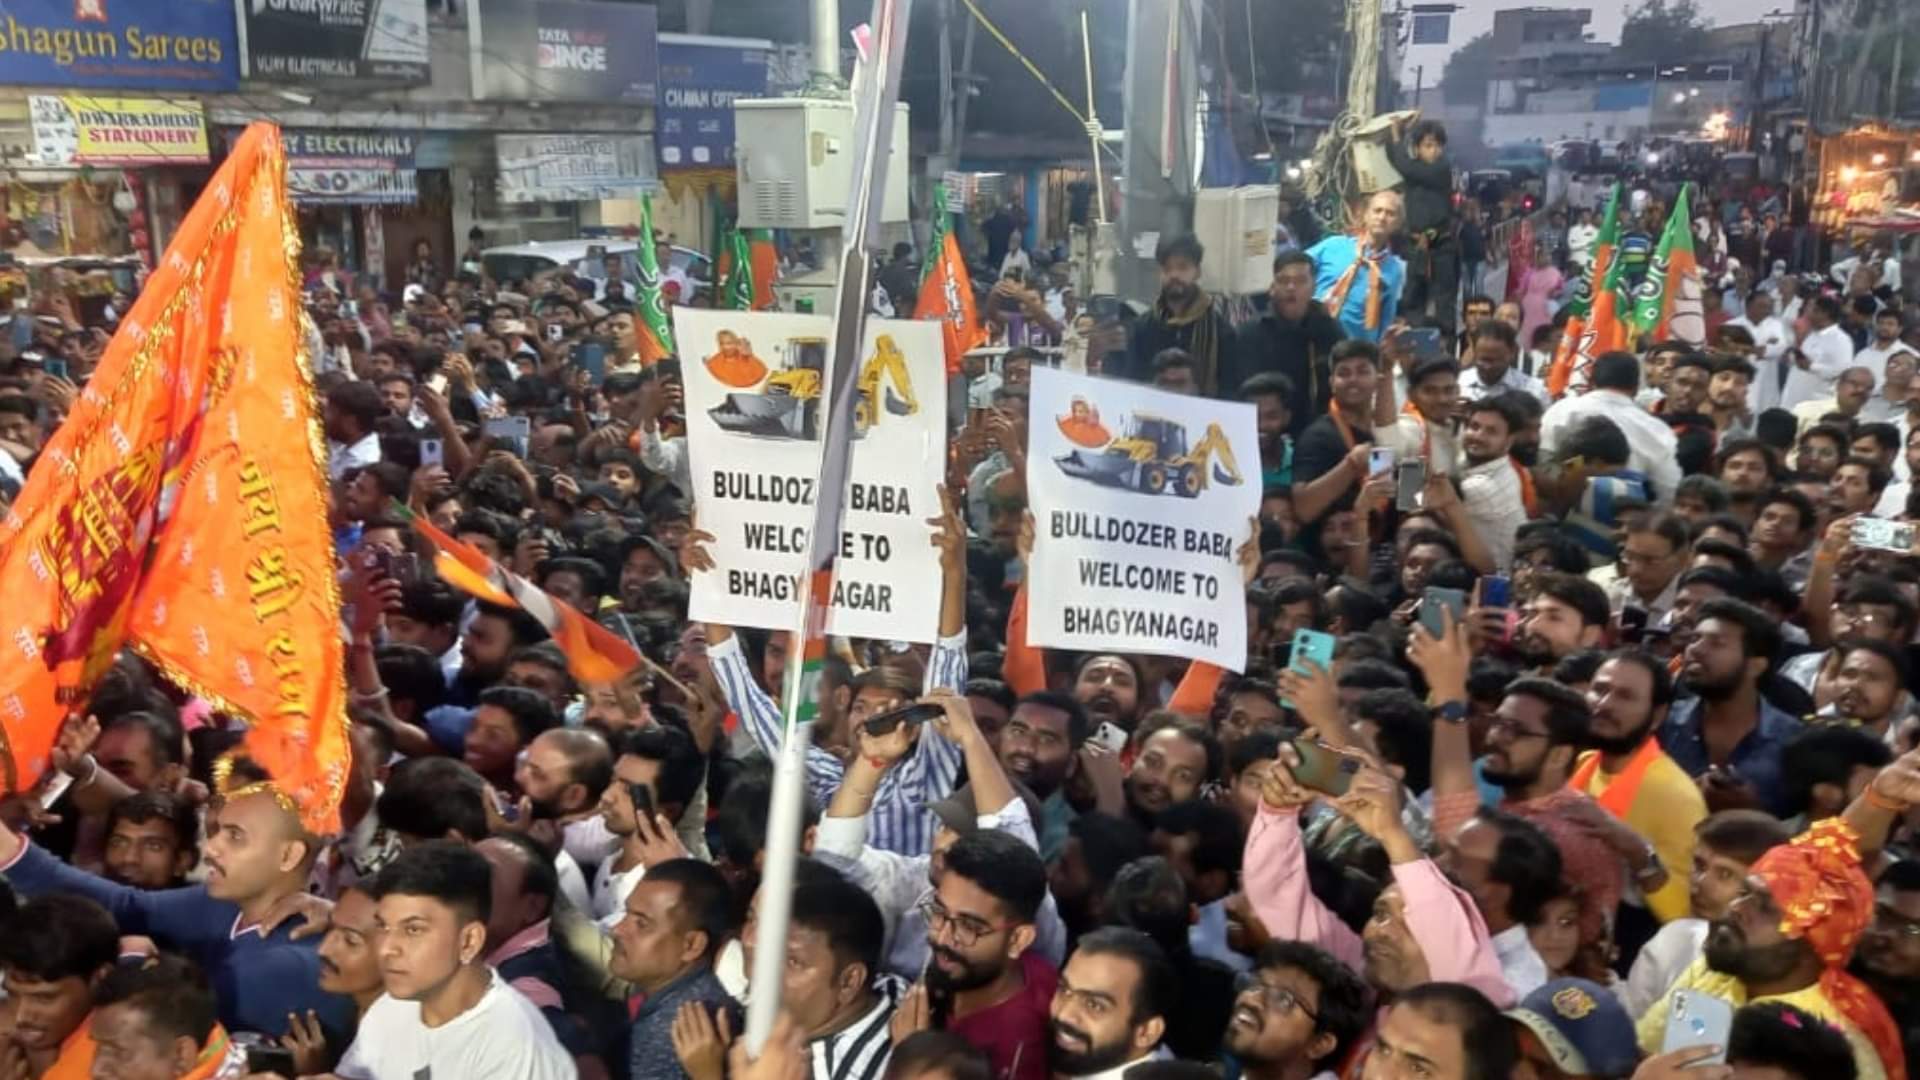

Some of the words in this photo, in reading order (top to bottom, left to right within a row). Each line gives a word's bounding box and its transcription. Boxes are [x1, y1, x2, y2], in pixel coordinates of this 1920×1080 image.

[126, 25, 223, 62] Sarees
[538, 28, 570, 42] TATA
[287, 57, 357, 77] ELECTRICALS
[88, 128, 199, 143] STATIONERY
[304, 134, 412, 156] ELECTRICALS
[713, 471, 815, 505] BULLDOZ
[851, 484, 911, 516] BABA
[744, 522, 854, 559] WELCE
[861, 533, 891, 562] TO
[1051, 511, 1177, 550] BULLDOZER
[1183, 528, 1233, 563] BABA
[729, 570, 892, 613] BHAGYAGAR
[1079, 558, 1186, 595] WELCOME
[1192, 573, 1219, 600] TO
[1064, 606, 1219, 648] BHAGYANAGAR
